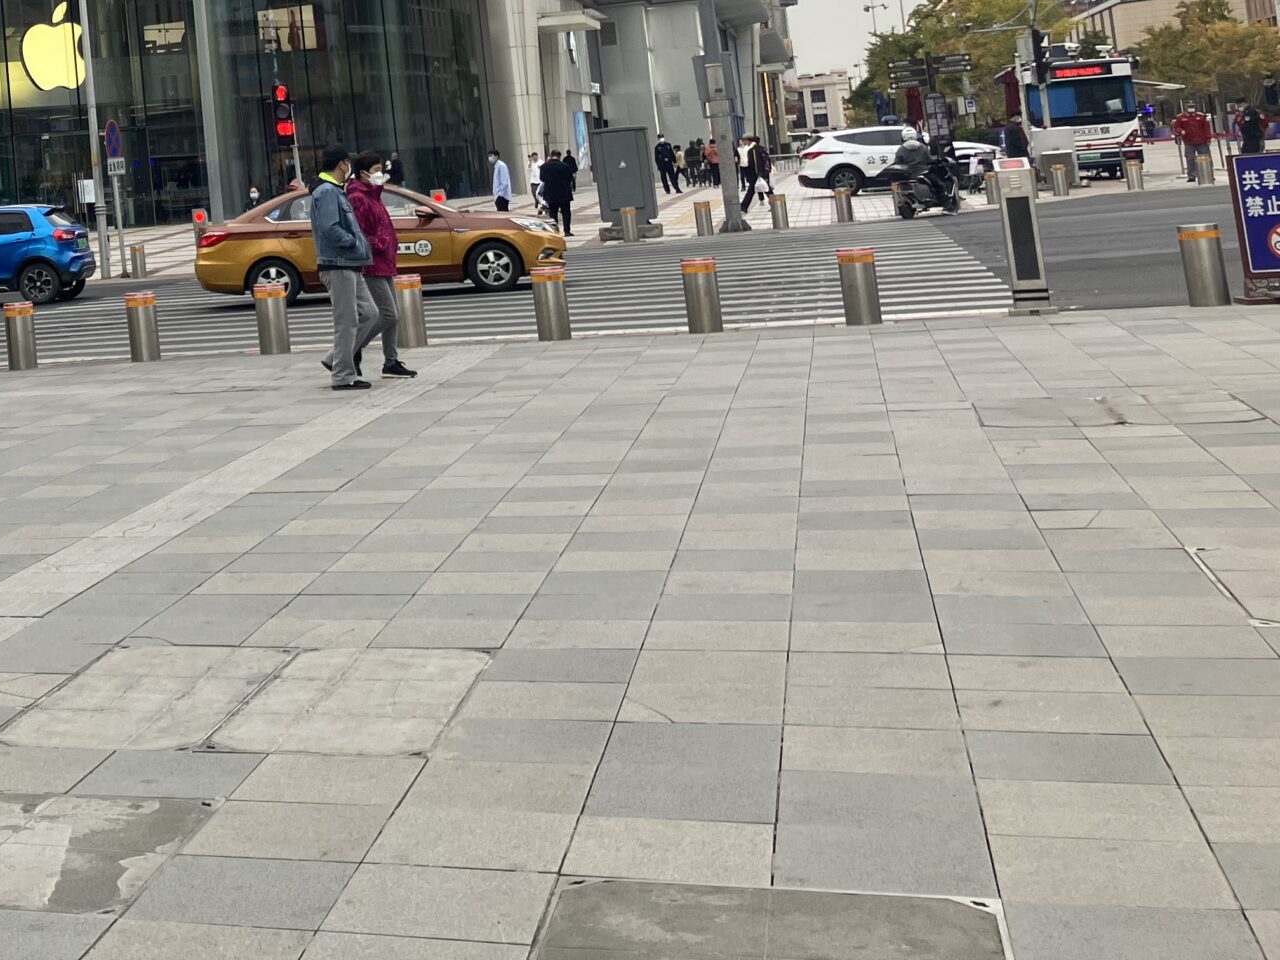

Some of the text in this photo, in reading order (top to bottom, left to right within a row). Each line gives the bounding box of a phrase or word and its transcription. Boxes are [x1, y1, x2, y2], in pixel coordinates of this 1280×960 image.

[866, 155, 889, 165] 公安
[1241, 168, 1280, 192] 共享
[1245, 195, 1280, 218] 禁止
